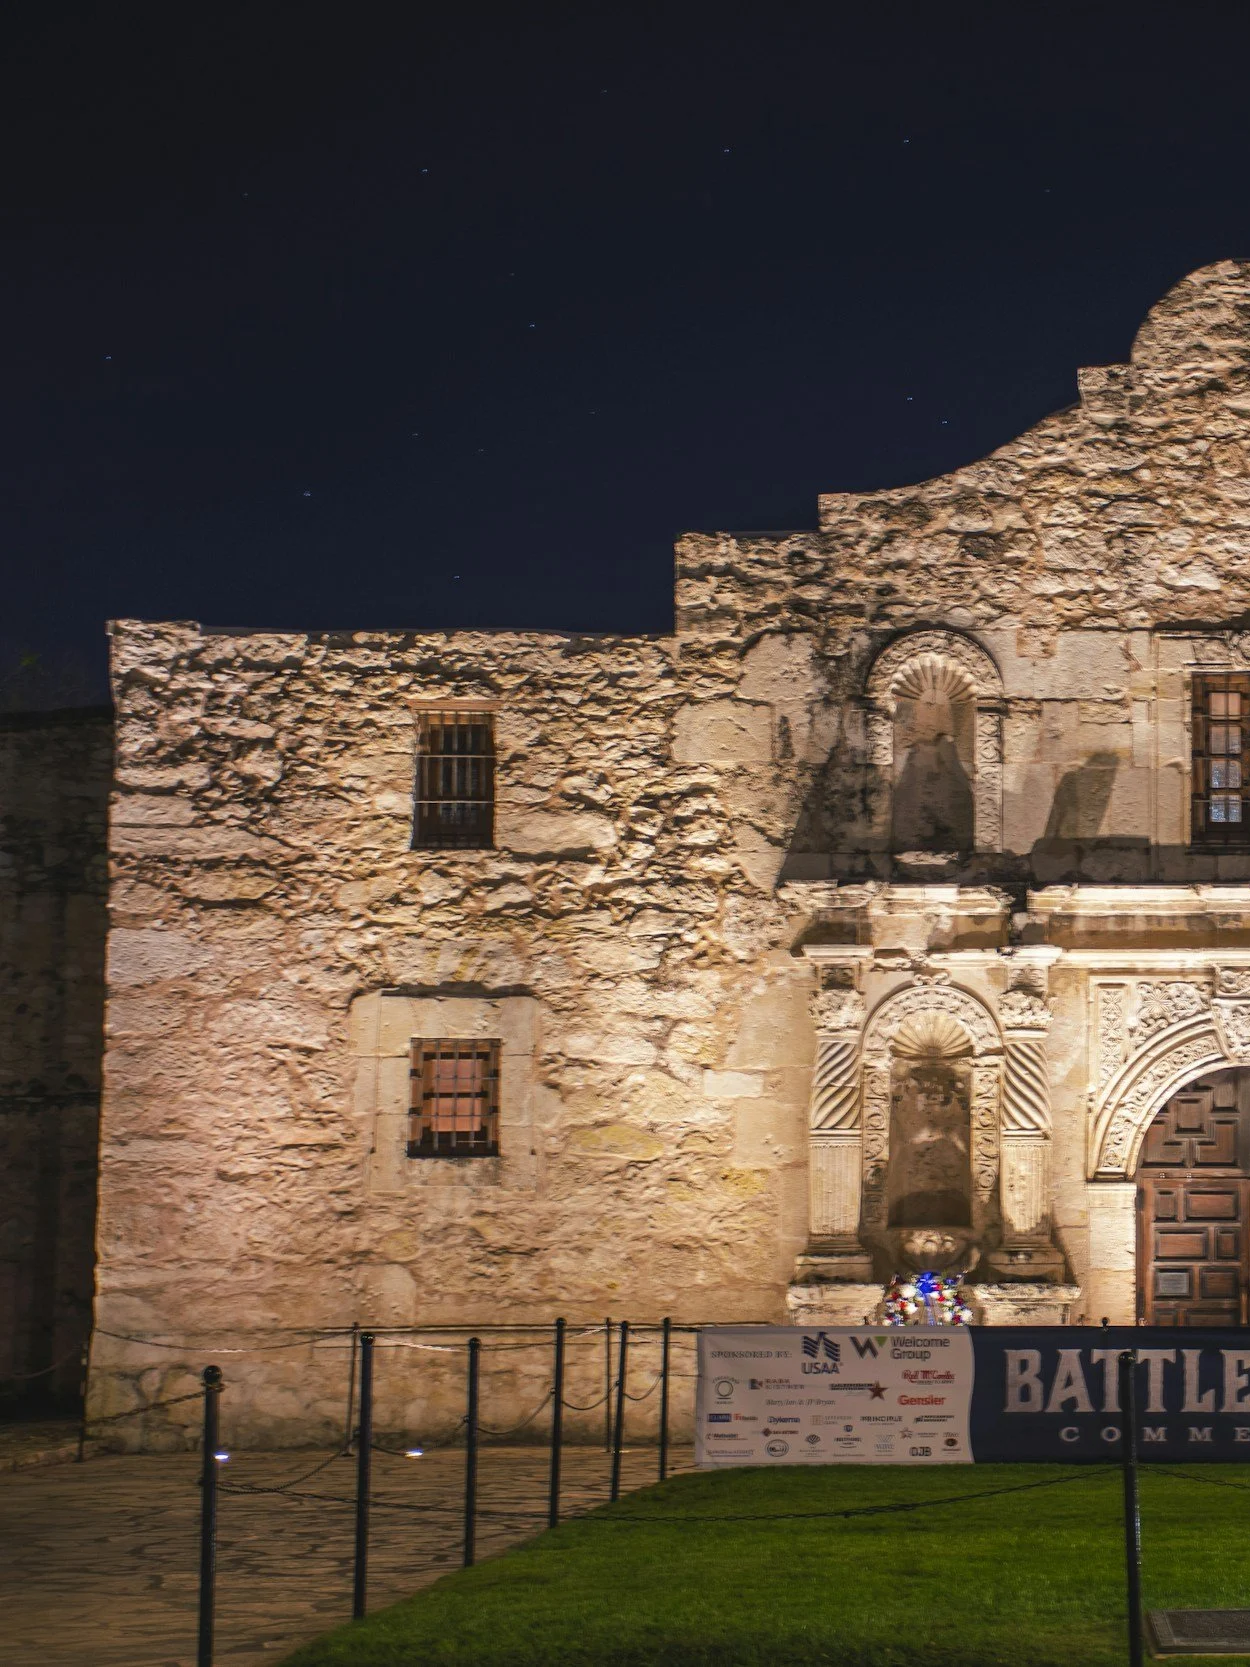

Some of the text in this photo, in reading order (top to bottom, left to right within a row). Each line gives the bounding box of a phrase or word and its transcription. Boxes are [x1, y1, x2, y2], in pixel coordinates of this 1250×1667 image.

[891, 1336, 951, 1348] Welcome
[711, 1350, 773, 1359] SPONSORED
[891, 1349, 931, 1361] Group
[801, 1362, 841, 1375] USAA
[897, 1394, 946, 1406] Gensler
